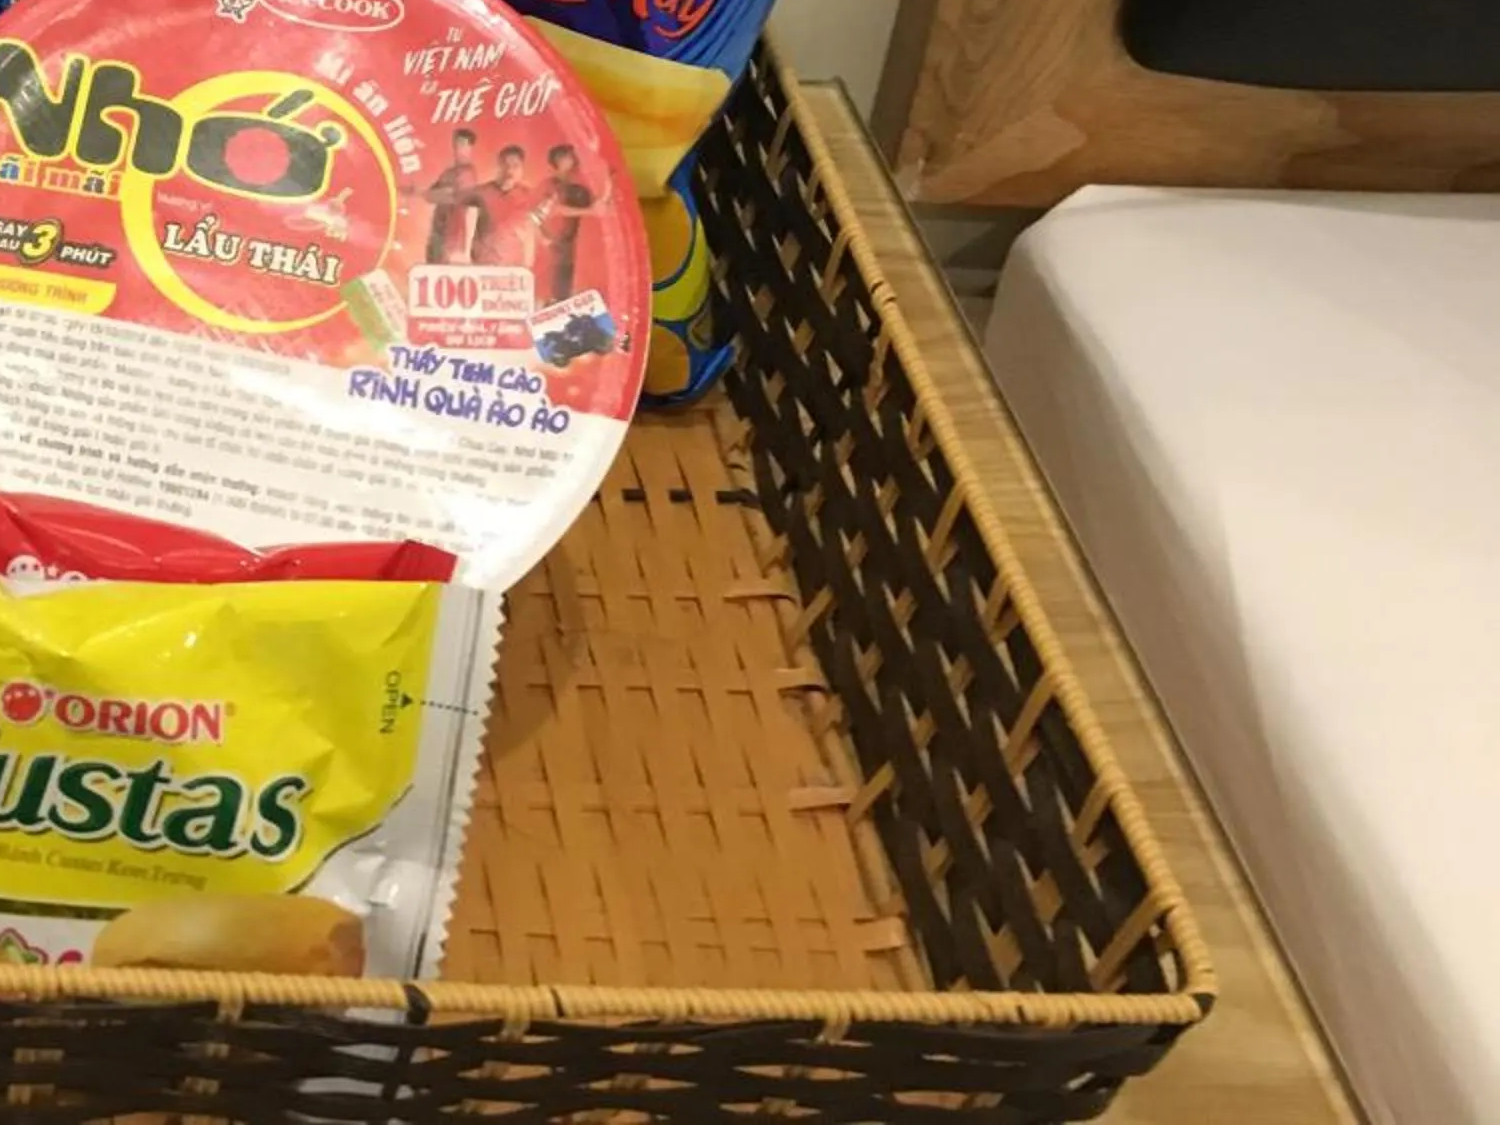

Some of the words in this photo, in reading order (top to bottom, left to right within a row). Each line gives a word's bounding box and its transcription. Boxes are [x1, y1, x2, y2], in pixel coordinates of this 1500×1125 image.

[404, 41, 455, 79] VIỆT
[455, 43, 505, 73] NAM
[41, 166, 122, 201] mãi
[22, 222, 60, 258] 3
[60, 243, 114, 266] PHÚT
[248, 241, 343, 286] THÁI
[413, 275, 479, 310] 100
[389, 345, 446, 375] THẤY
[449, 358, 496, 385] TEM
[498, 366, 543, 394] CÀO
[424, 384, 484, 423] QUÀ
[487, 391, 526, 428] ÀO
[531, 399, 570, 435] ÀO
[52, 694, 225, 742] ORION
[380, 670, 402, 735] OPEN
